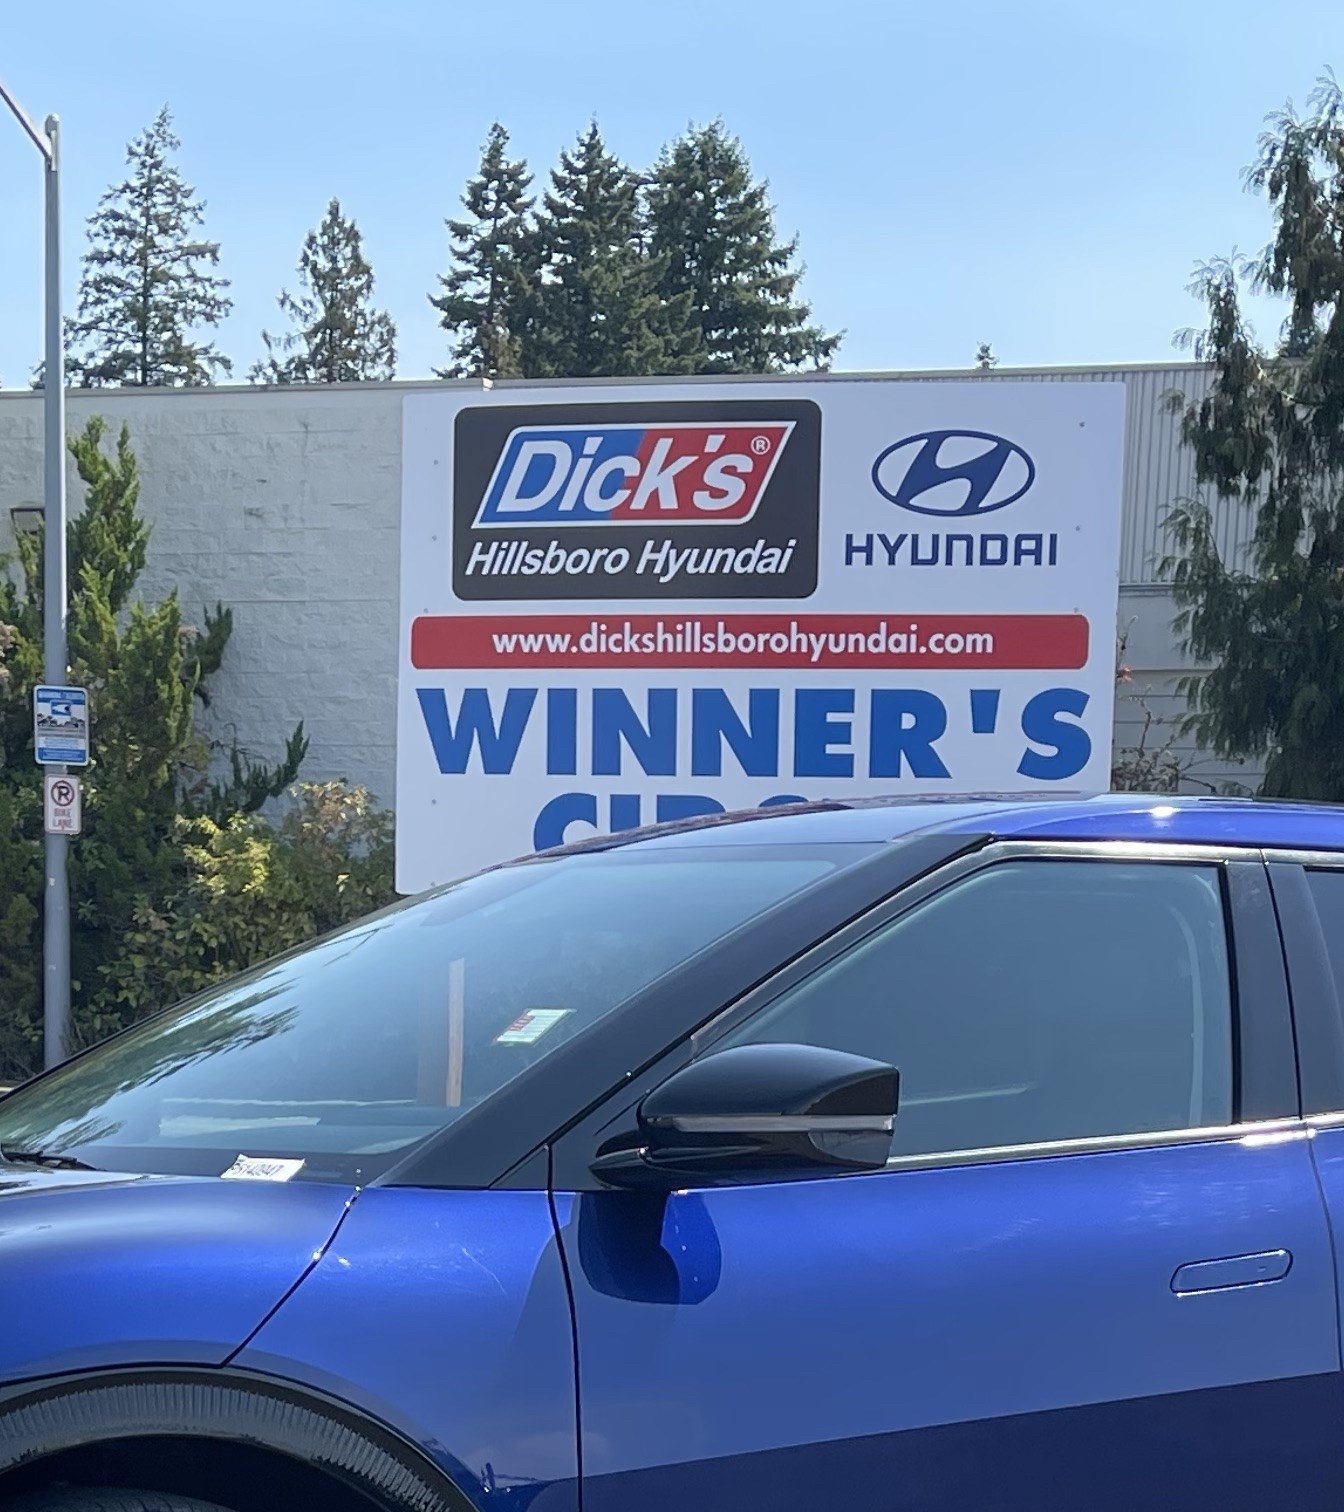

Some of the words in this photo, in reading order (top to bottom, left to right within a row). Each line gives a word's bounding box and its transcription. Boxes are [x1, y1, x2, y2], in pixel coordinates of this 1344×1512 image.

[465, 540, 630, 576] Hillsboro
[636, 538, 796, 583] Hyundai
[844, 532, 1058, 567] HYUNDAI
[492, 622, 994, 662] www.dickshillsborohyundai.com
[415, 687, 1092, 780] WINNER'S
